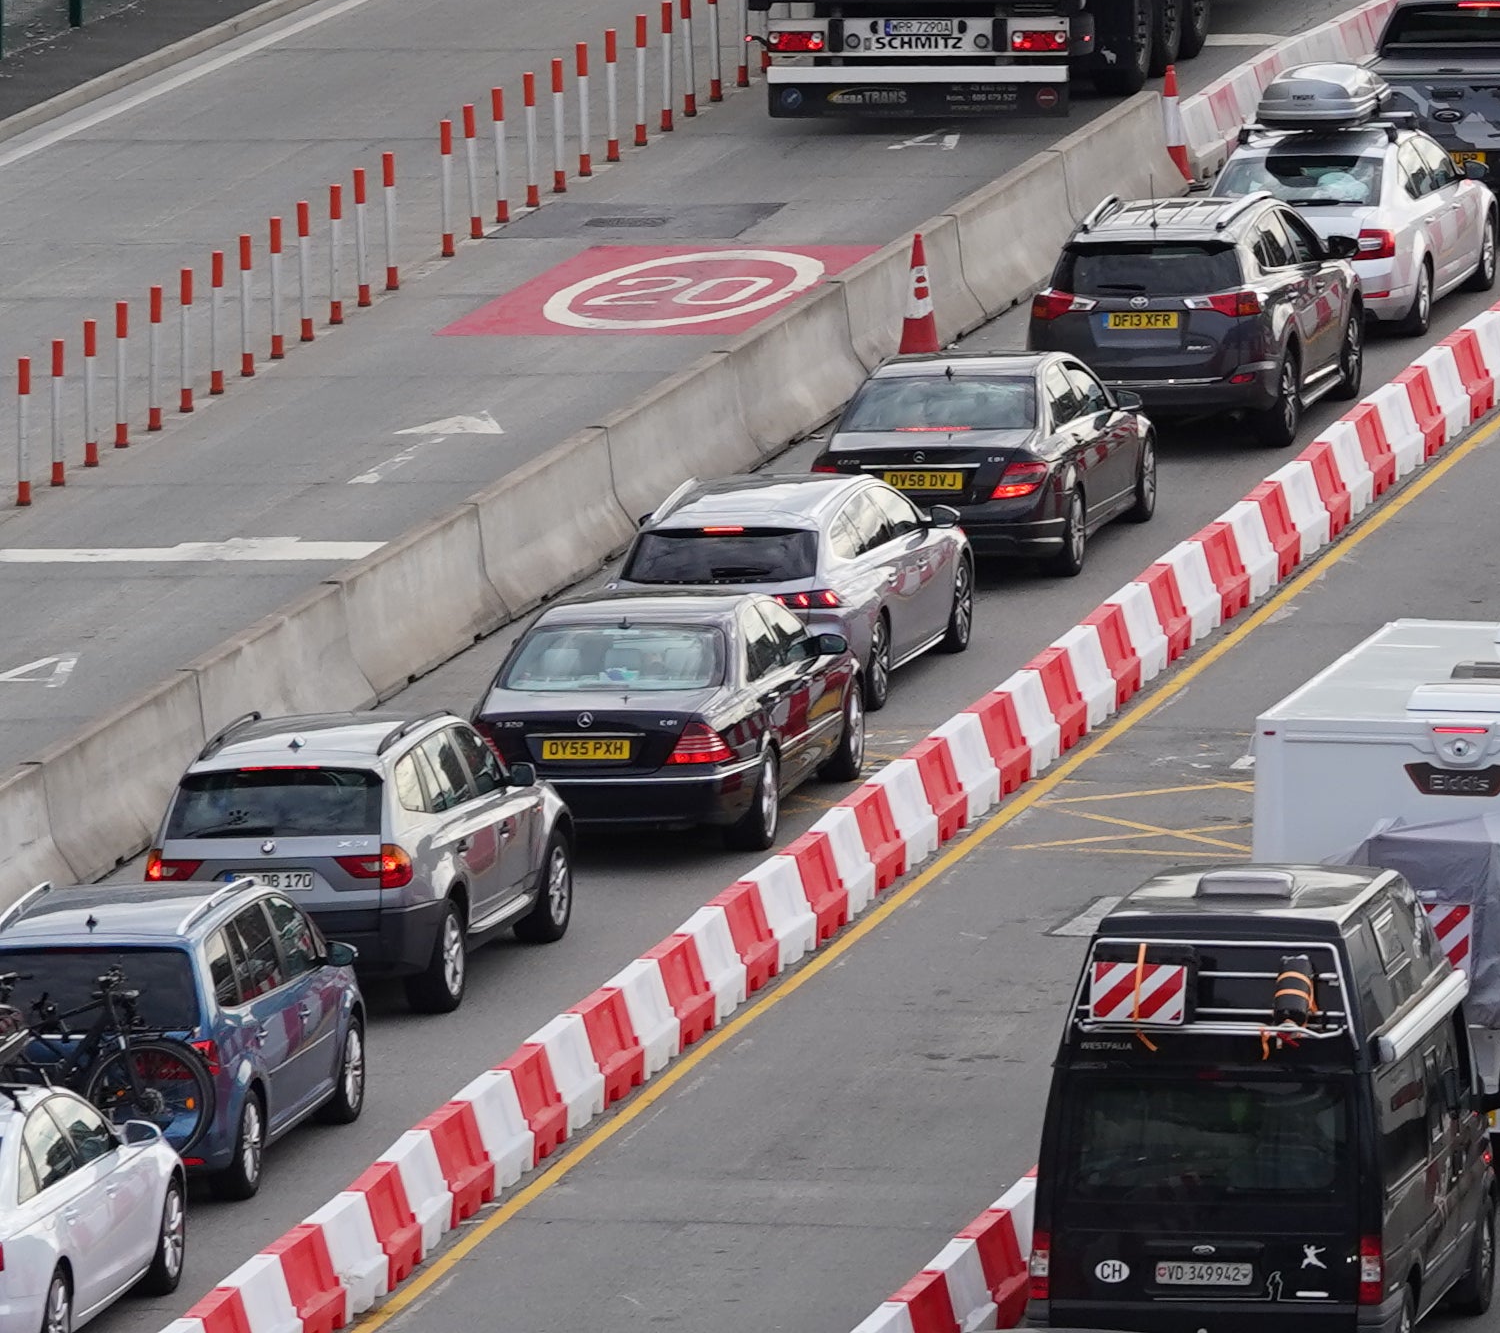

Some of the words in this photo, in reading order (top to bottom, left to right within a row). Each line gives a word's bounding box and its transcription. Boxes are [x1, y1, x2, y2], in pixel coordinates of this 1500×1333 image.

[891, 19, 915, 33] WPR
[916, 19, 950, 33] 7290A
[875, 36, 963, 50] SCHMITZ
[584, 276, 774, 306] 20
[1112, 313, 1143, 328] DF13
[1145, 314, 1171, 328] XFR
[928, 474, 956, 488] DVJ
[549, 741, 590, 757] OY55
[593, 742, 625, 757] PXH
[284, 873, 312, 887] 170
[1079, 1041, 1134, 1051] WESTFALIA
[1100, 1262, 1123, 1276] CH
